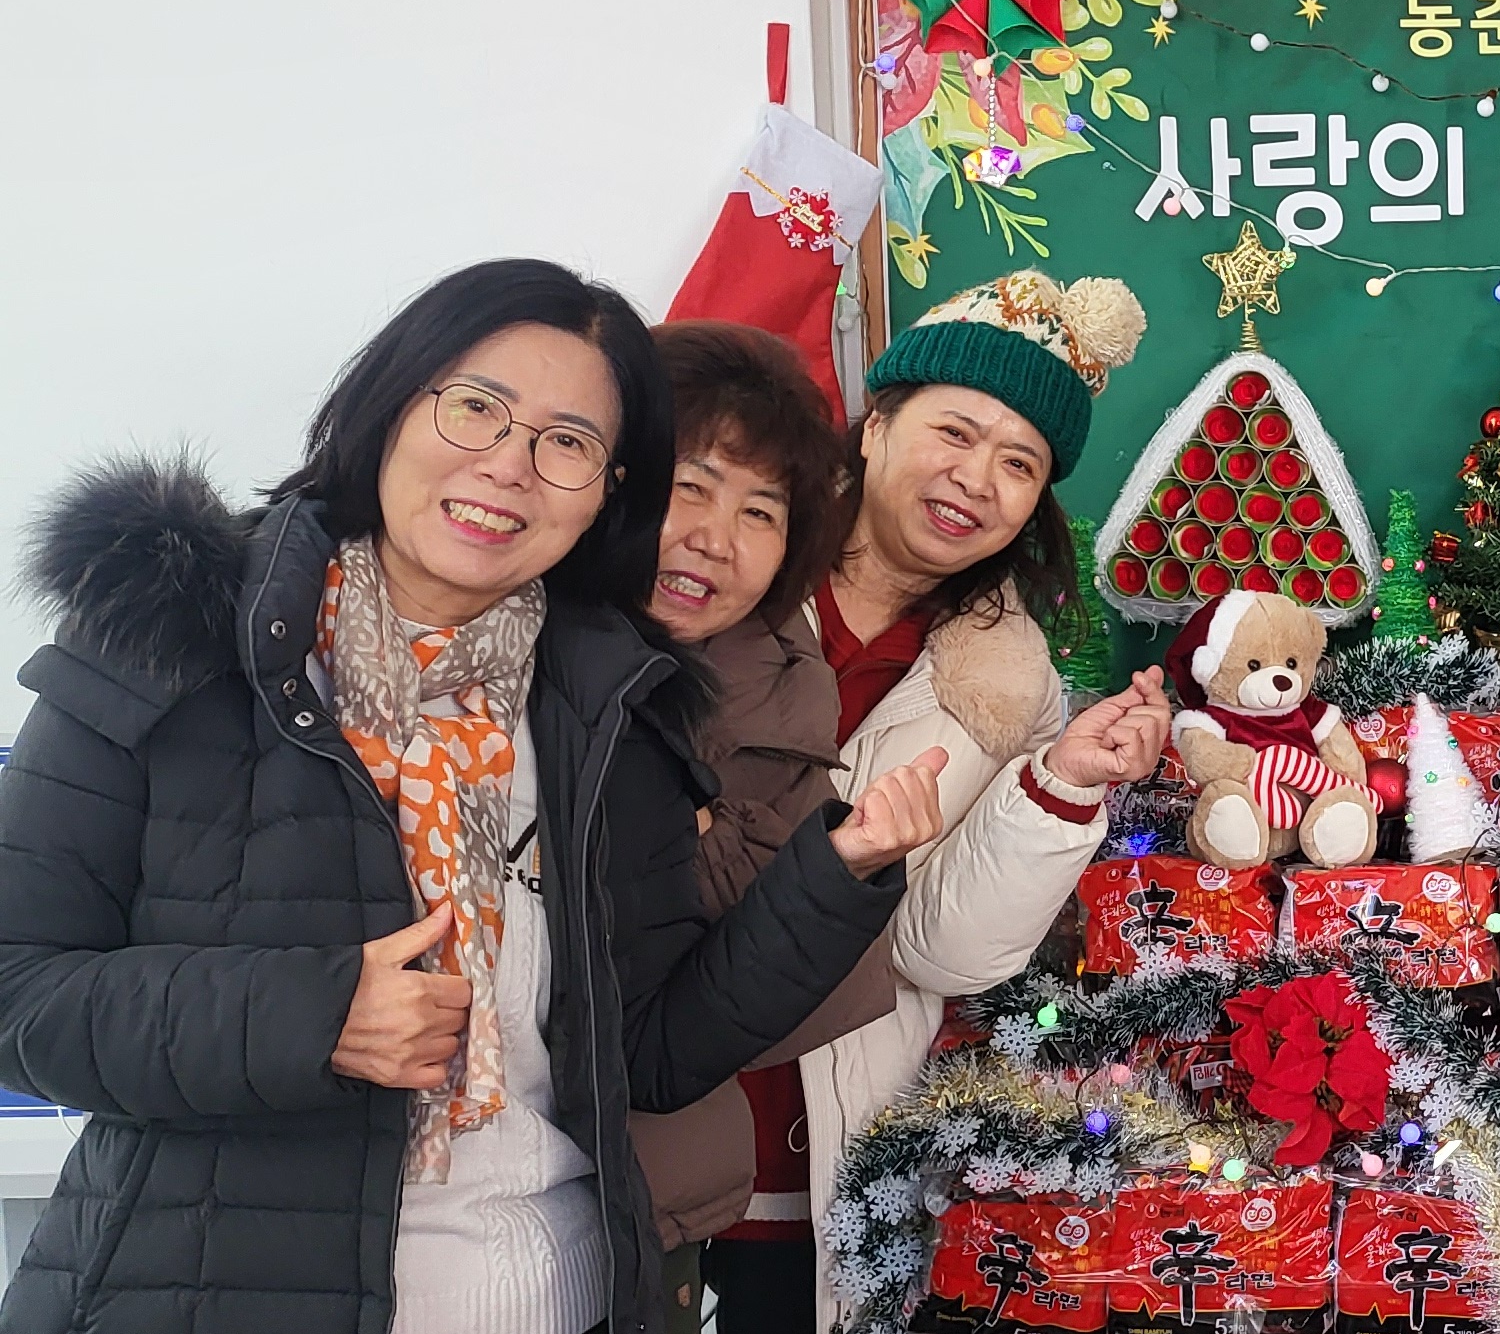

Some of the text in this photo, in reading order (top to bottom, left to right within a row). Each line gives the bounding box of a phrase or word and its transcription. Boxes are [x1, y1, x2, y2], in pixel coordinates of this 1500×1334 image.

[1134, 112, 1466, 246] 사랑의
[1183, 934, 1229, 954] 라면
[976, 1233, 1081, 1327] 辛 라면
[1151, 1220, 1276, 1327] 辛 라면
[1384, 1225, 1468, 1332] 辛
